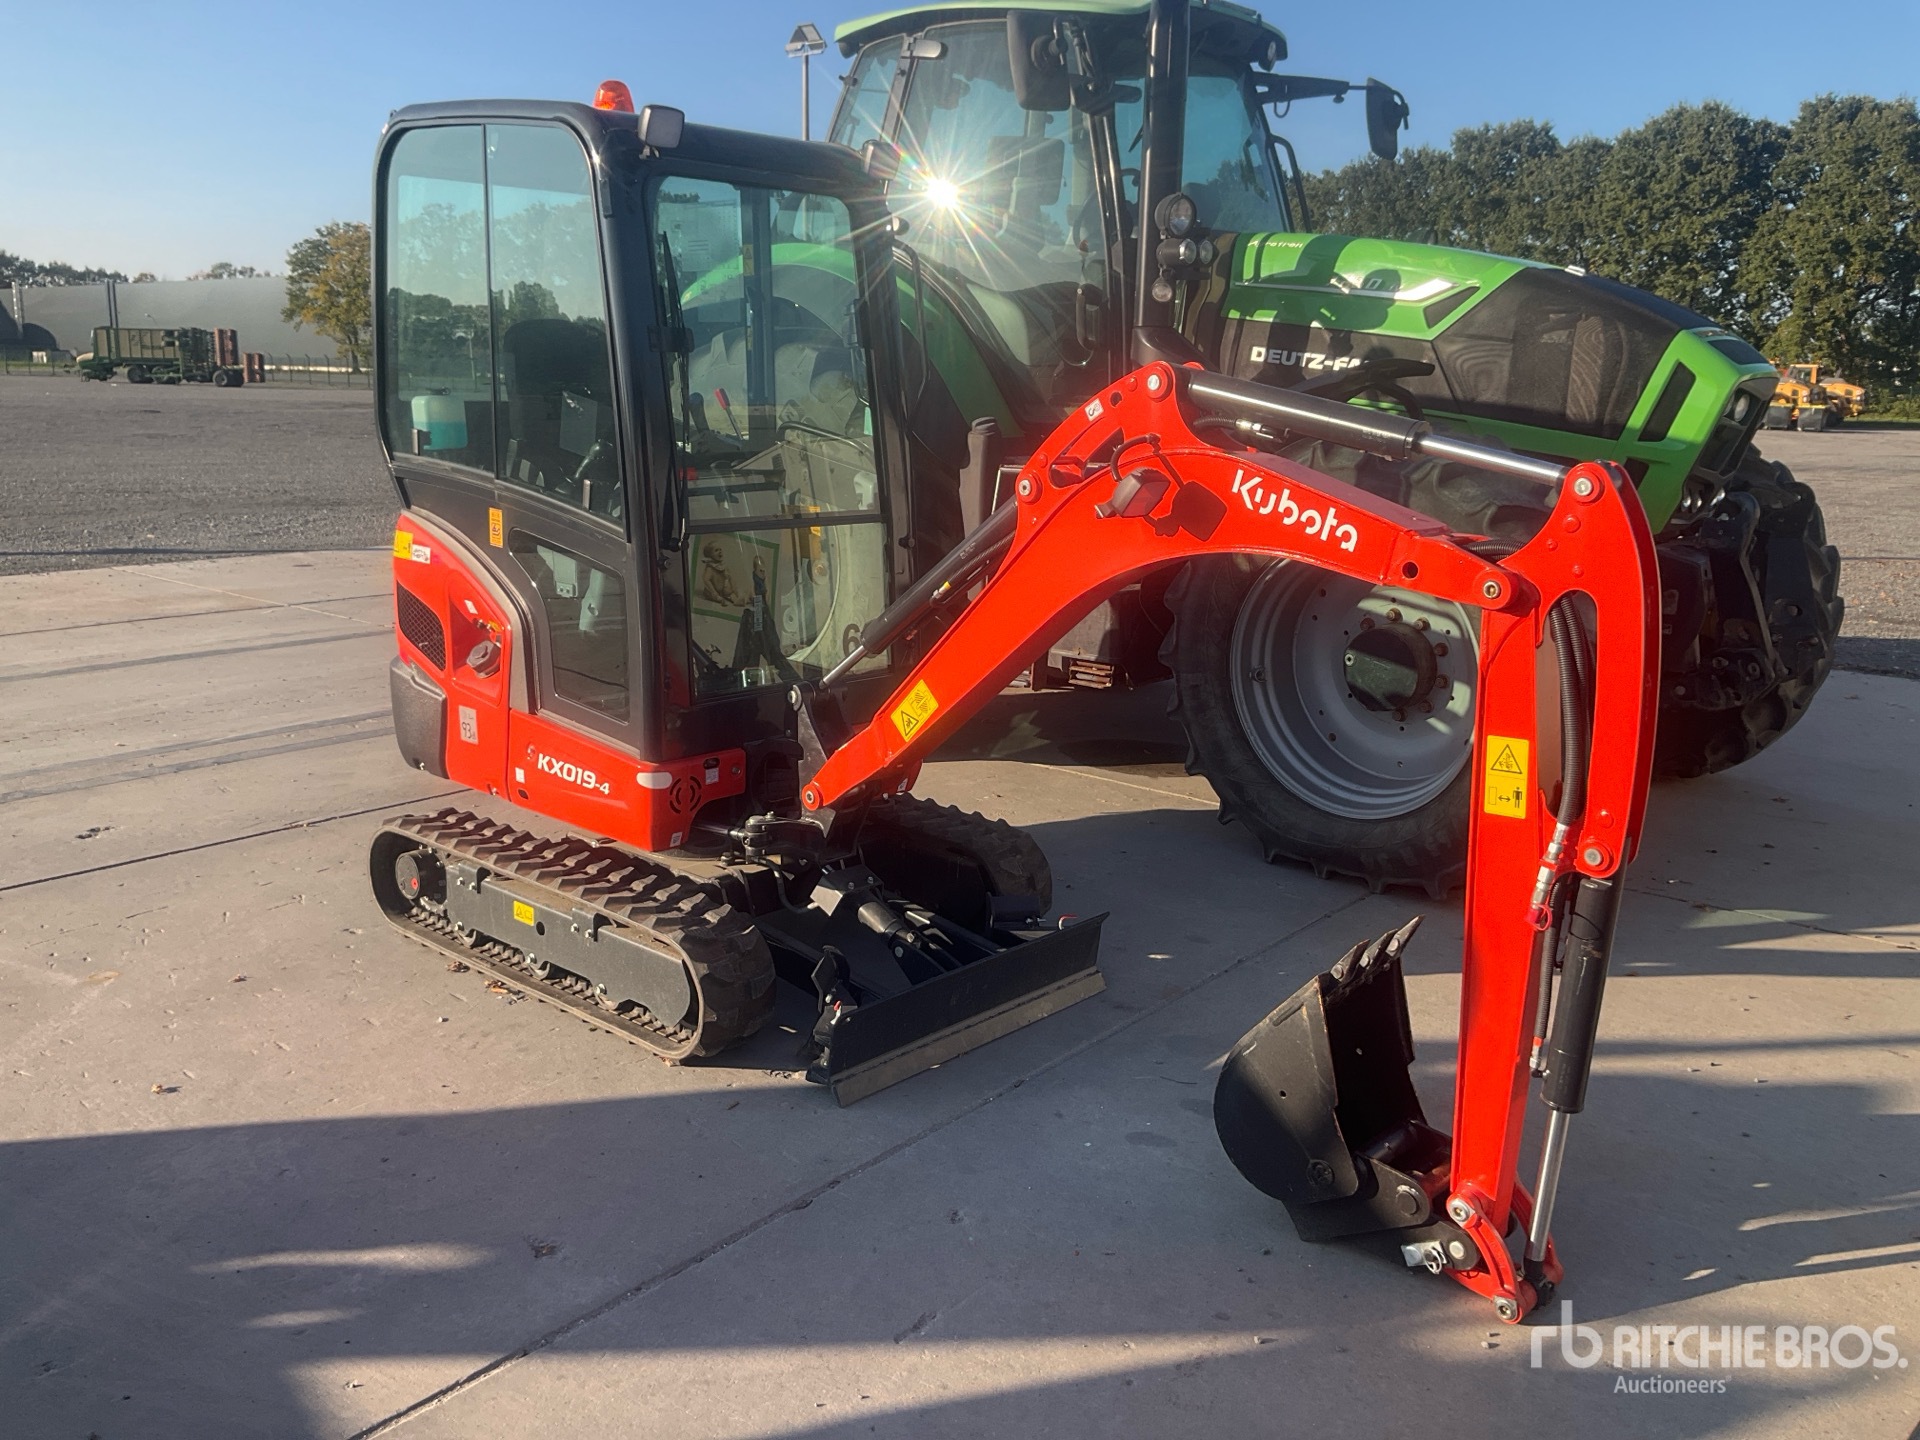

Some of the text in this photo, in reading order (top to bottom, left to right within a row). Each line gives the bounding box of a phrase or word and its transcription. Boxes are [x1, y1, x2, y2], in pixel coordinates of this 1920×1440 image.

[1250, 346, 1369, 371] DEUTZ-FA
[1231, 468, 1358, 553] Kubota
[461, 721, 472, 739] 93
[537, 753, 610, 795] KX019-4
